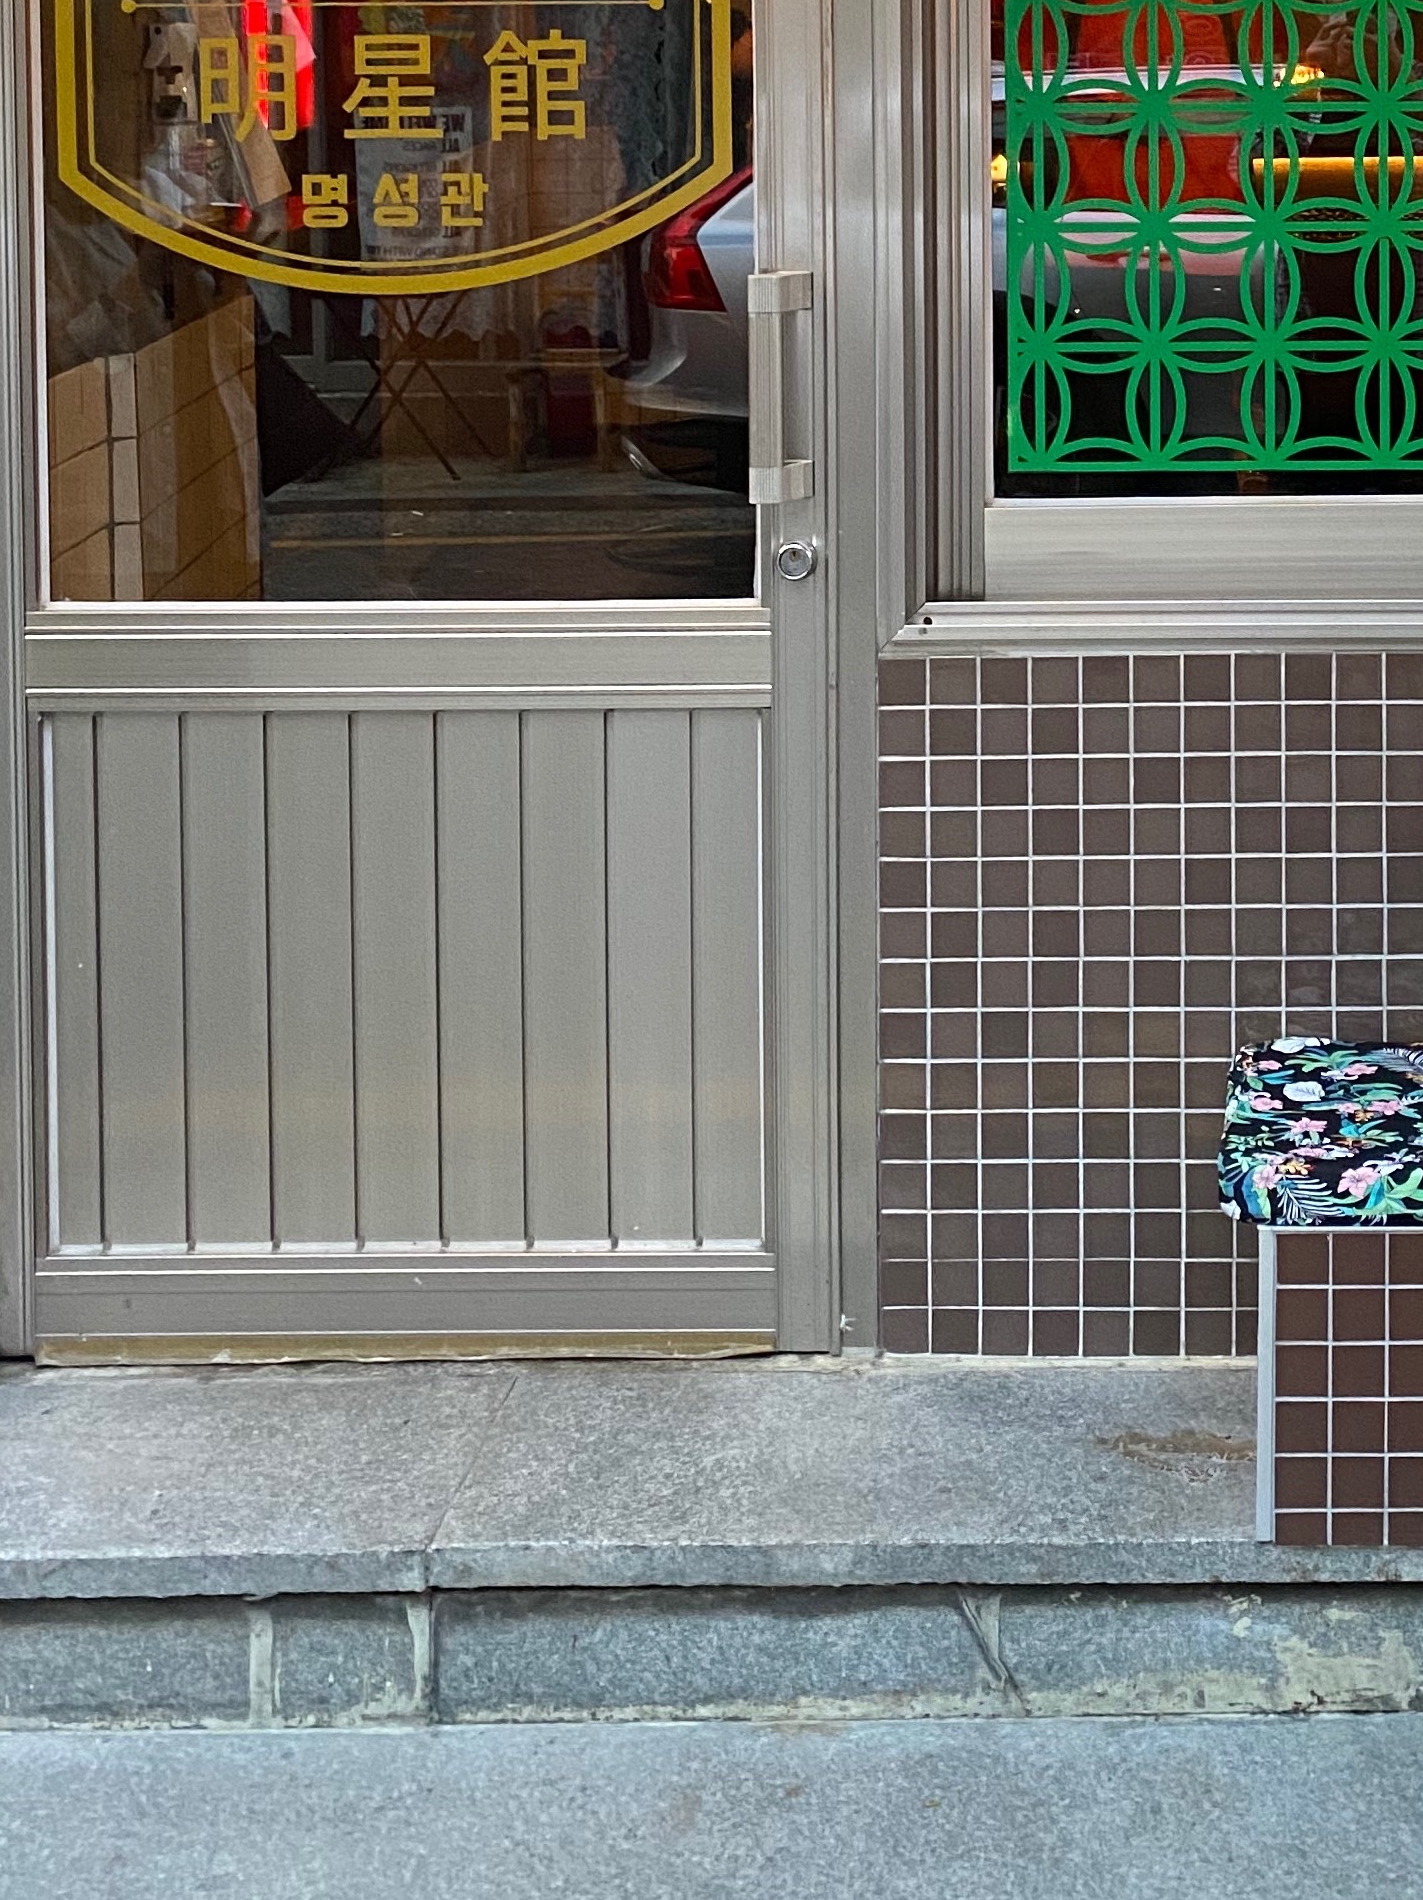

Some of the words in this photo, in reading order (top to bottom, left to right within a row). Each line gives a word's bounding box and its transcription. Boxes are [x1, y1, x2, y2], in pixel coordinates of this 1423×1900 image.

[200, 29, 587, 143] 明星館
[301, 172, 489, 229] 명성관
